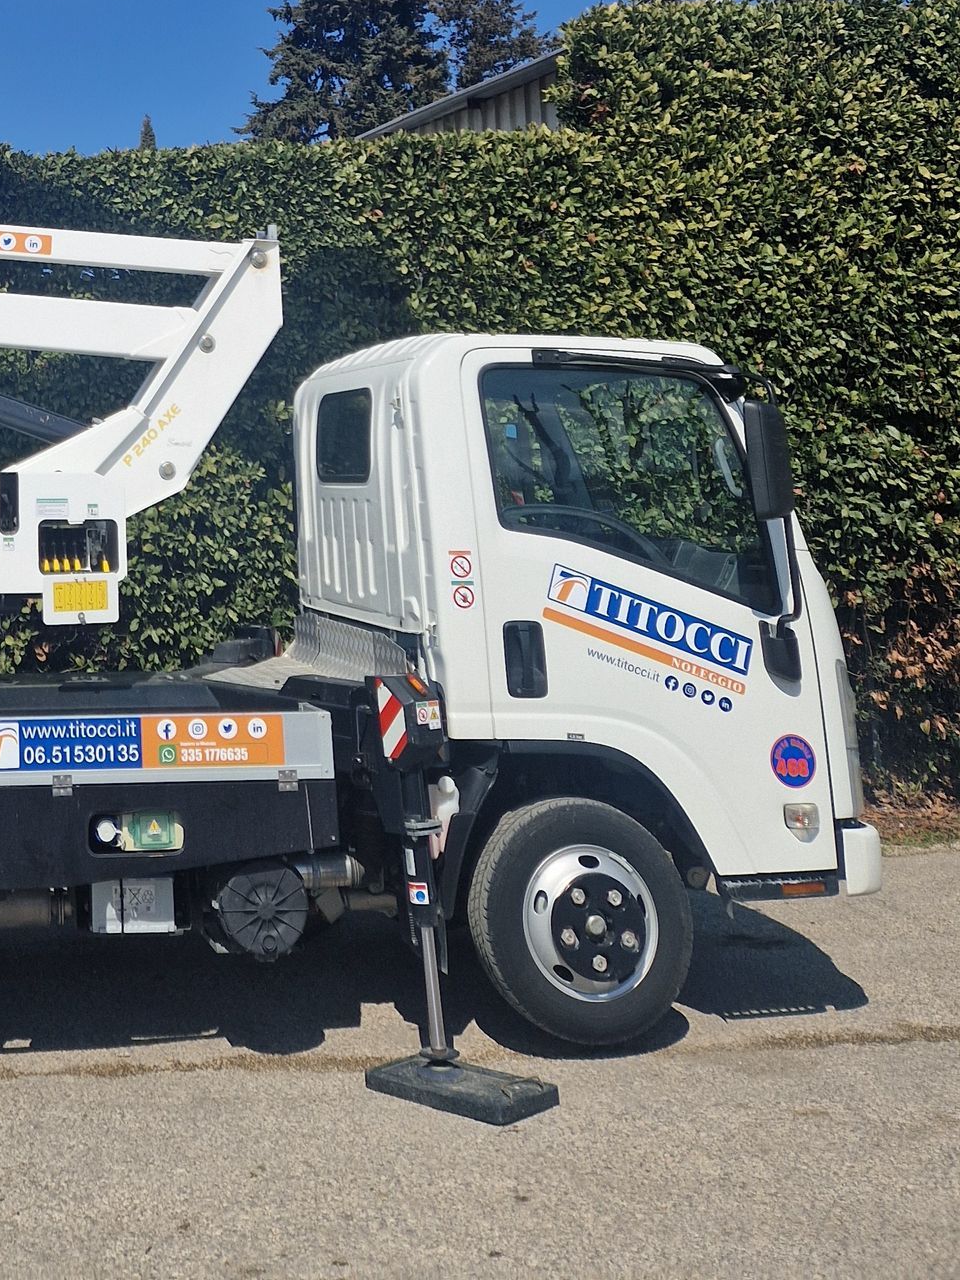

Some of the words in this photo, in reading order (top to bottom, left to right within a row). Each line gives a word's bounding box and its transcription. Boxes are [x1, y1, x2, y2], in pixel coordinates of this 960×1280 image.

[122, 454, 133, 467] P
[157, 403, 182, 431] AXE
[594, 583, 752, 671] TITOCCI
[587, 647, 661, 683] www.titocci.it
[671, 657, 743, 694] NOLEGGIO
[22, 722, 137, 740] www.titocci.it
[24, 744, 139, 764] 06.51530135
[181, 748, 203, 762] 335
[204, 747, 249, 762] 1776635
